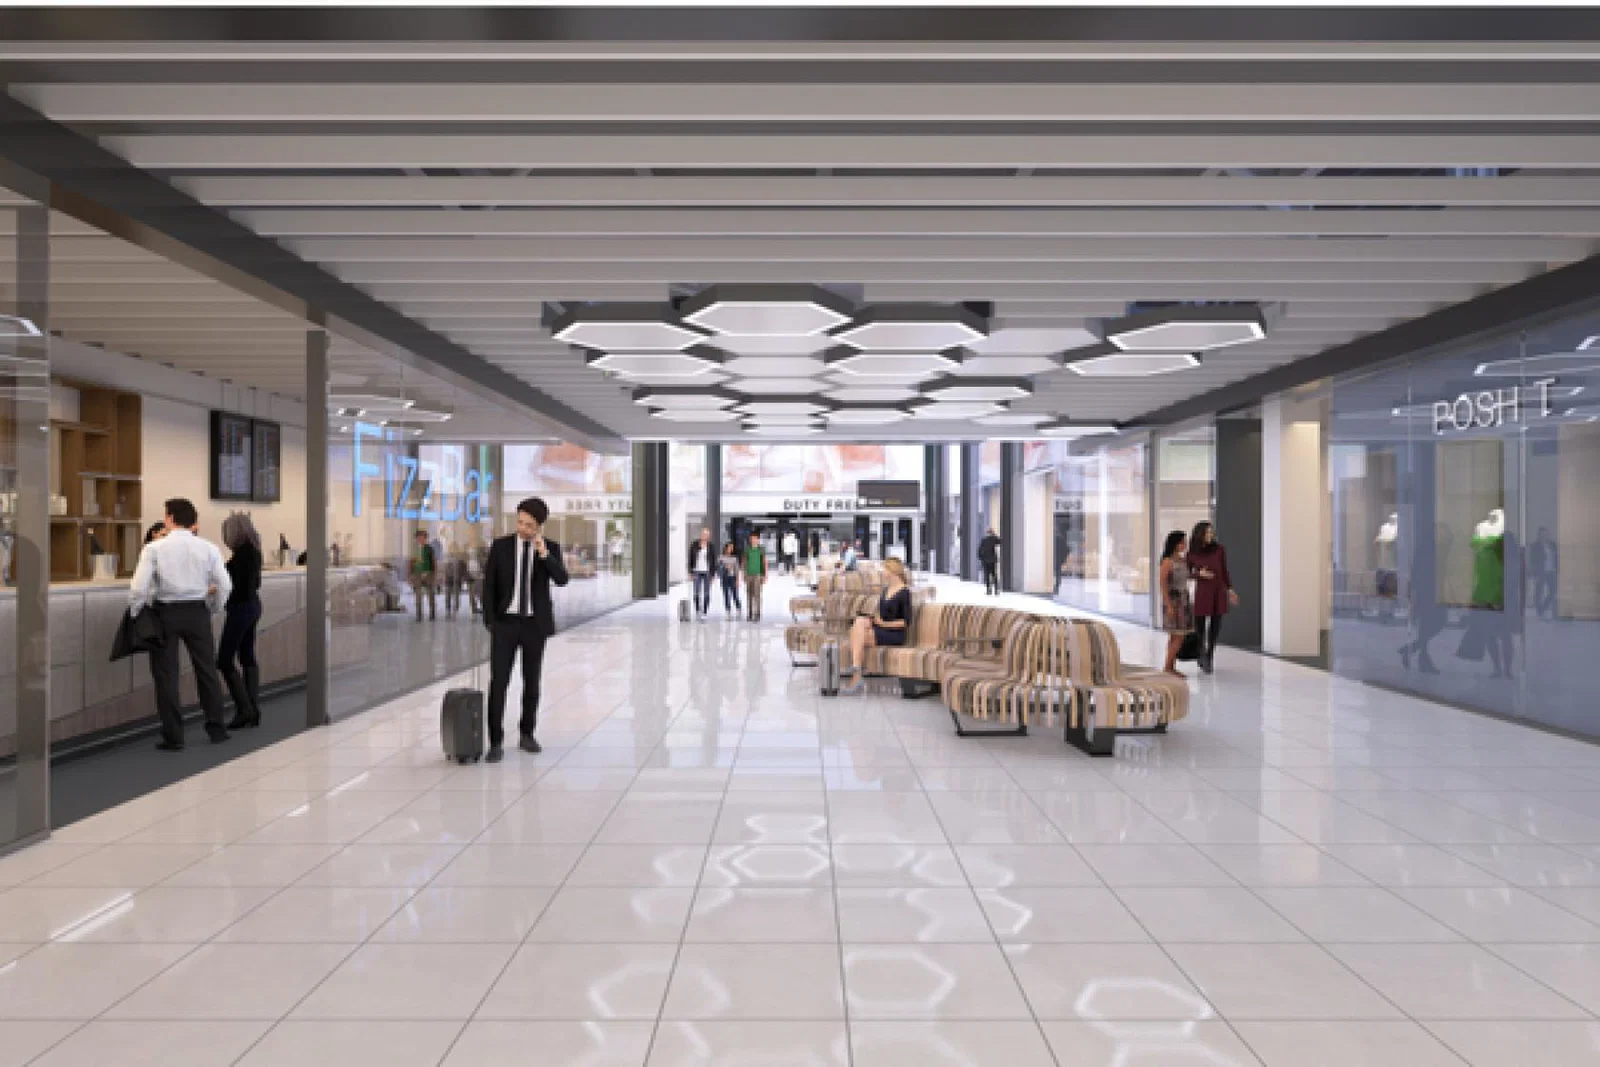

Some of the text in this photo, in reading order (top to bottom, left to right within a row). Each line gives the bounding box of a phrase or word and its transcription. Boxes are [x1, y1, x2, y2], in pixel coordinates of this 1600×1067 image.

[1433, 387, 1519, 435] POSH
[353, 420, 494, 523] FizzBar
[783, 498, 820, 510] DUTY
